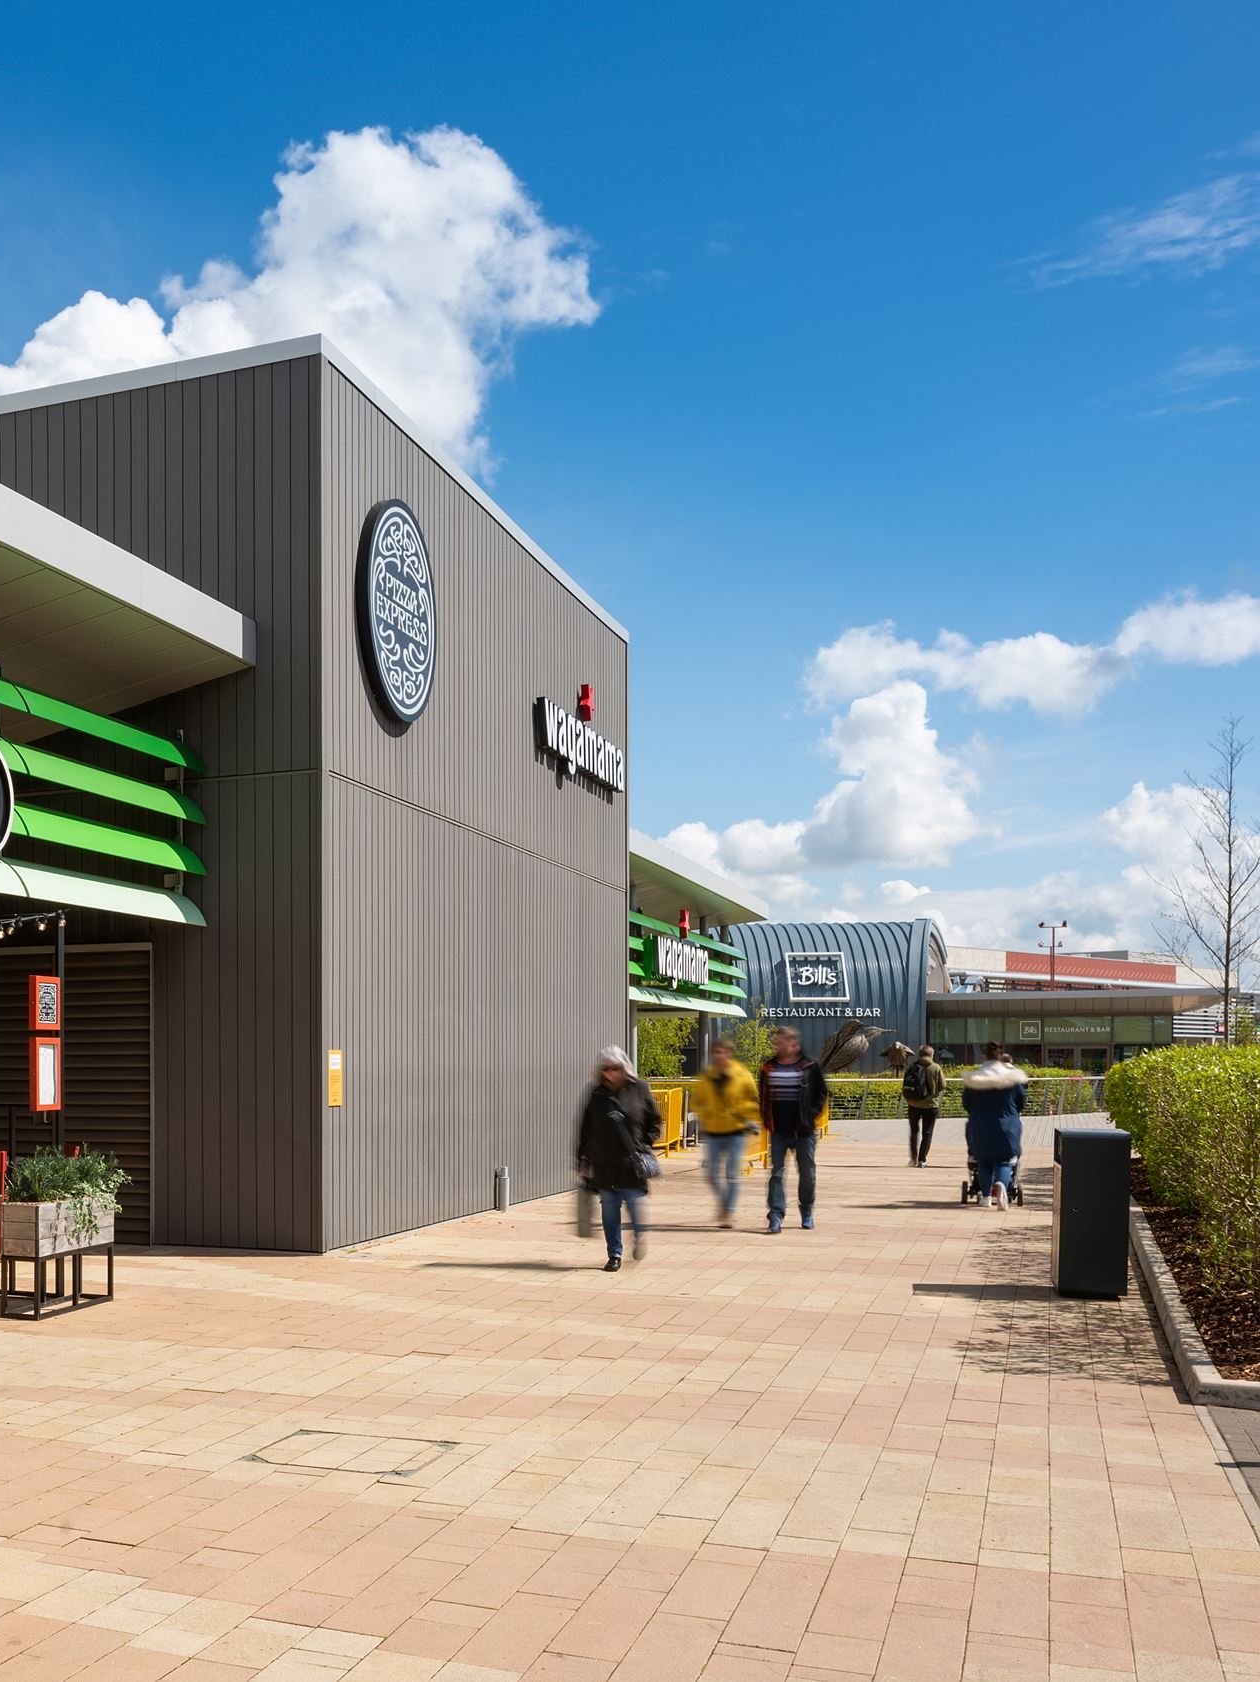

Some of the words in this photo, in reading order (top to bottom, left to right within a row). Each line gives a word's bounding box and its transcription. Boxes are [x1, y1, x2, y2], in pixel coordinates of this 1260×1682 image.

[385, 571, 418, 616] PIZZA
[376, 591, 428, 646] EXPRESS
[544, 698, 624, 791] wagamama
[658, 936, 708, 989] wagamama
[797, 964, 837, 985] Bill's
[761, 1008, 841, 1017] RESTAURANT
[845, 1008, 853, 1017] &
[856, 1008, 881, 1017] BAR
